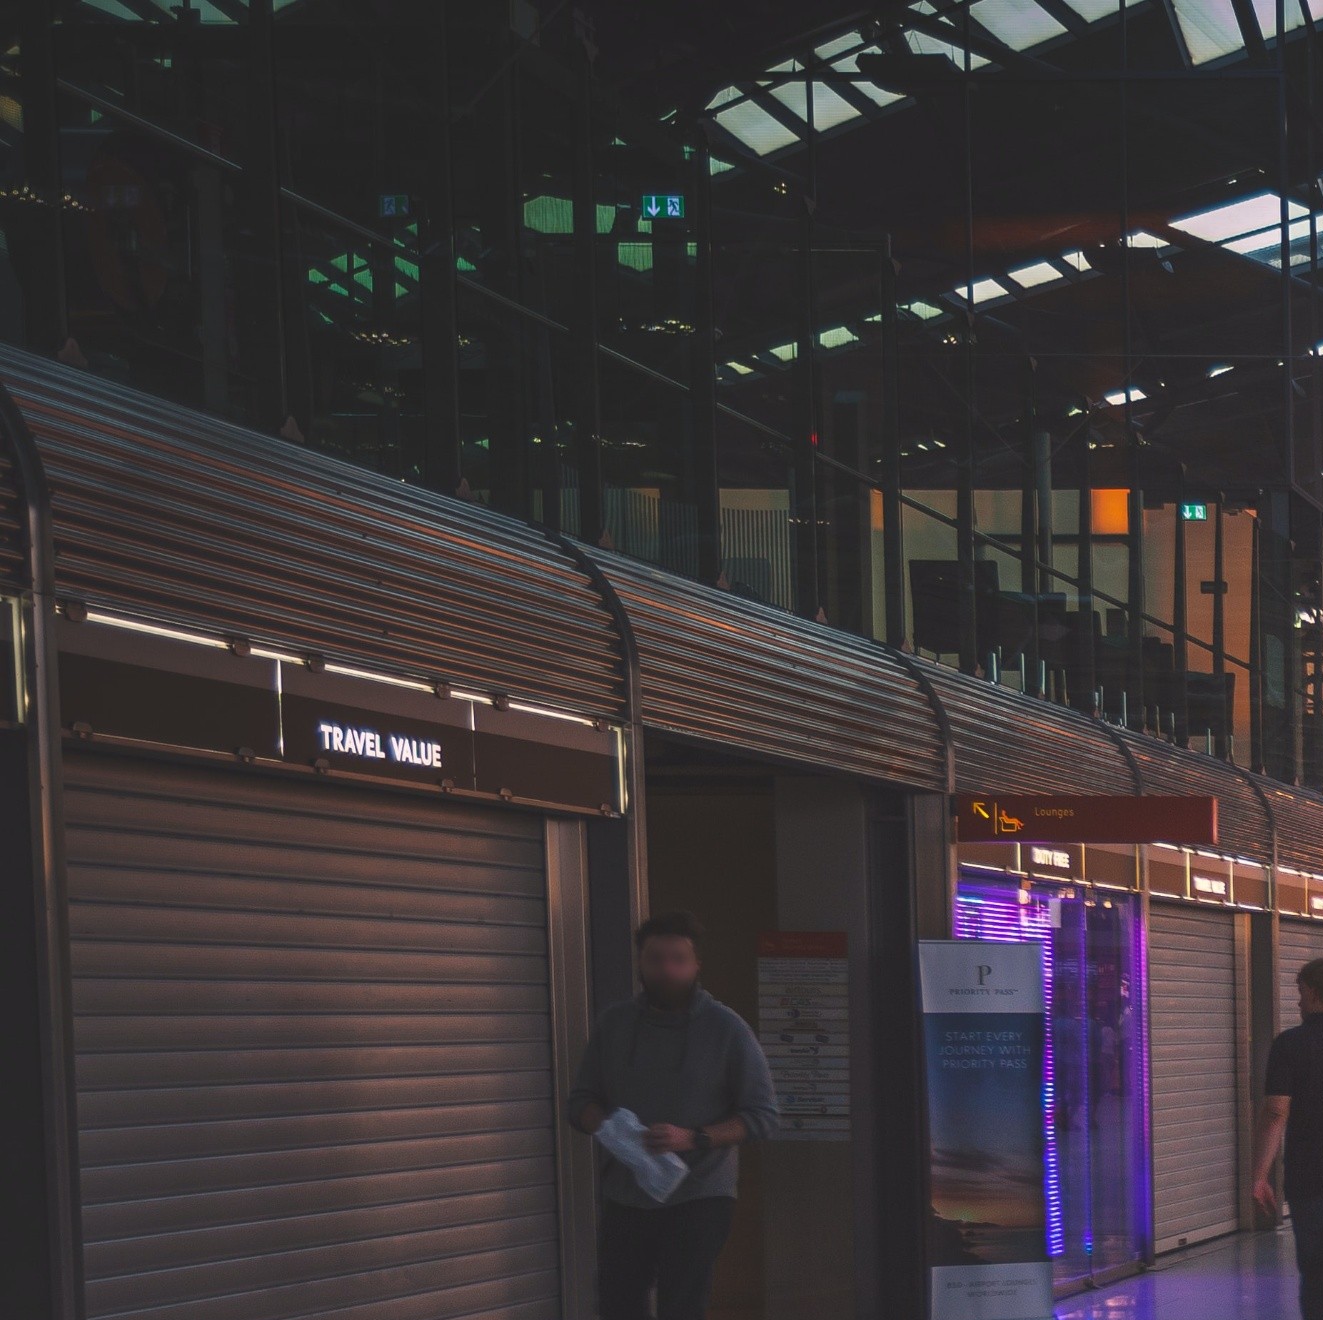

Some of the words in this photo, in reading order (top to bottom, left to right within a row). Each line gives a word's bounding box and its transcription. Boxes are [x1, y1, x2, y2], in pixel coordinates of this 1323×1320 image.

[320, 724, 386, 759] TRAVEL
[391, 736, 442, 768] VALUE
[1034, 807, 1075, 819] Lounges
[1032, 847, 1052, 865] DUTY
[1053, 851, 1070, 868] FREE
[977, 965, 992, 985] P
[949, 988, 991, 996] PRIORITY
[945, 1031, 982, 1042] START
[986, 1031, 1023, 1042] EVERY
[938, 1045, 996, 1056] JOURNEY
[999, 1045, 1031, 1056] WITH
[943, 1059, 994, 1069] PRIORITY
[1000, 1059, 1028, 1069] PASS
